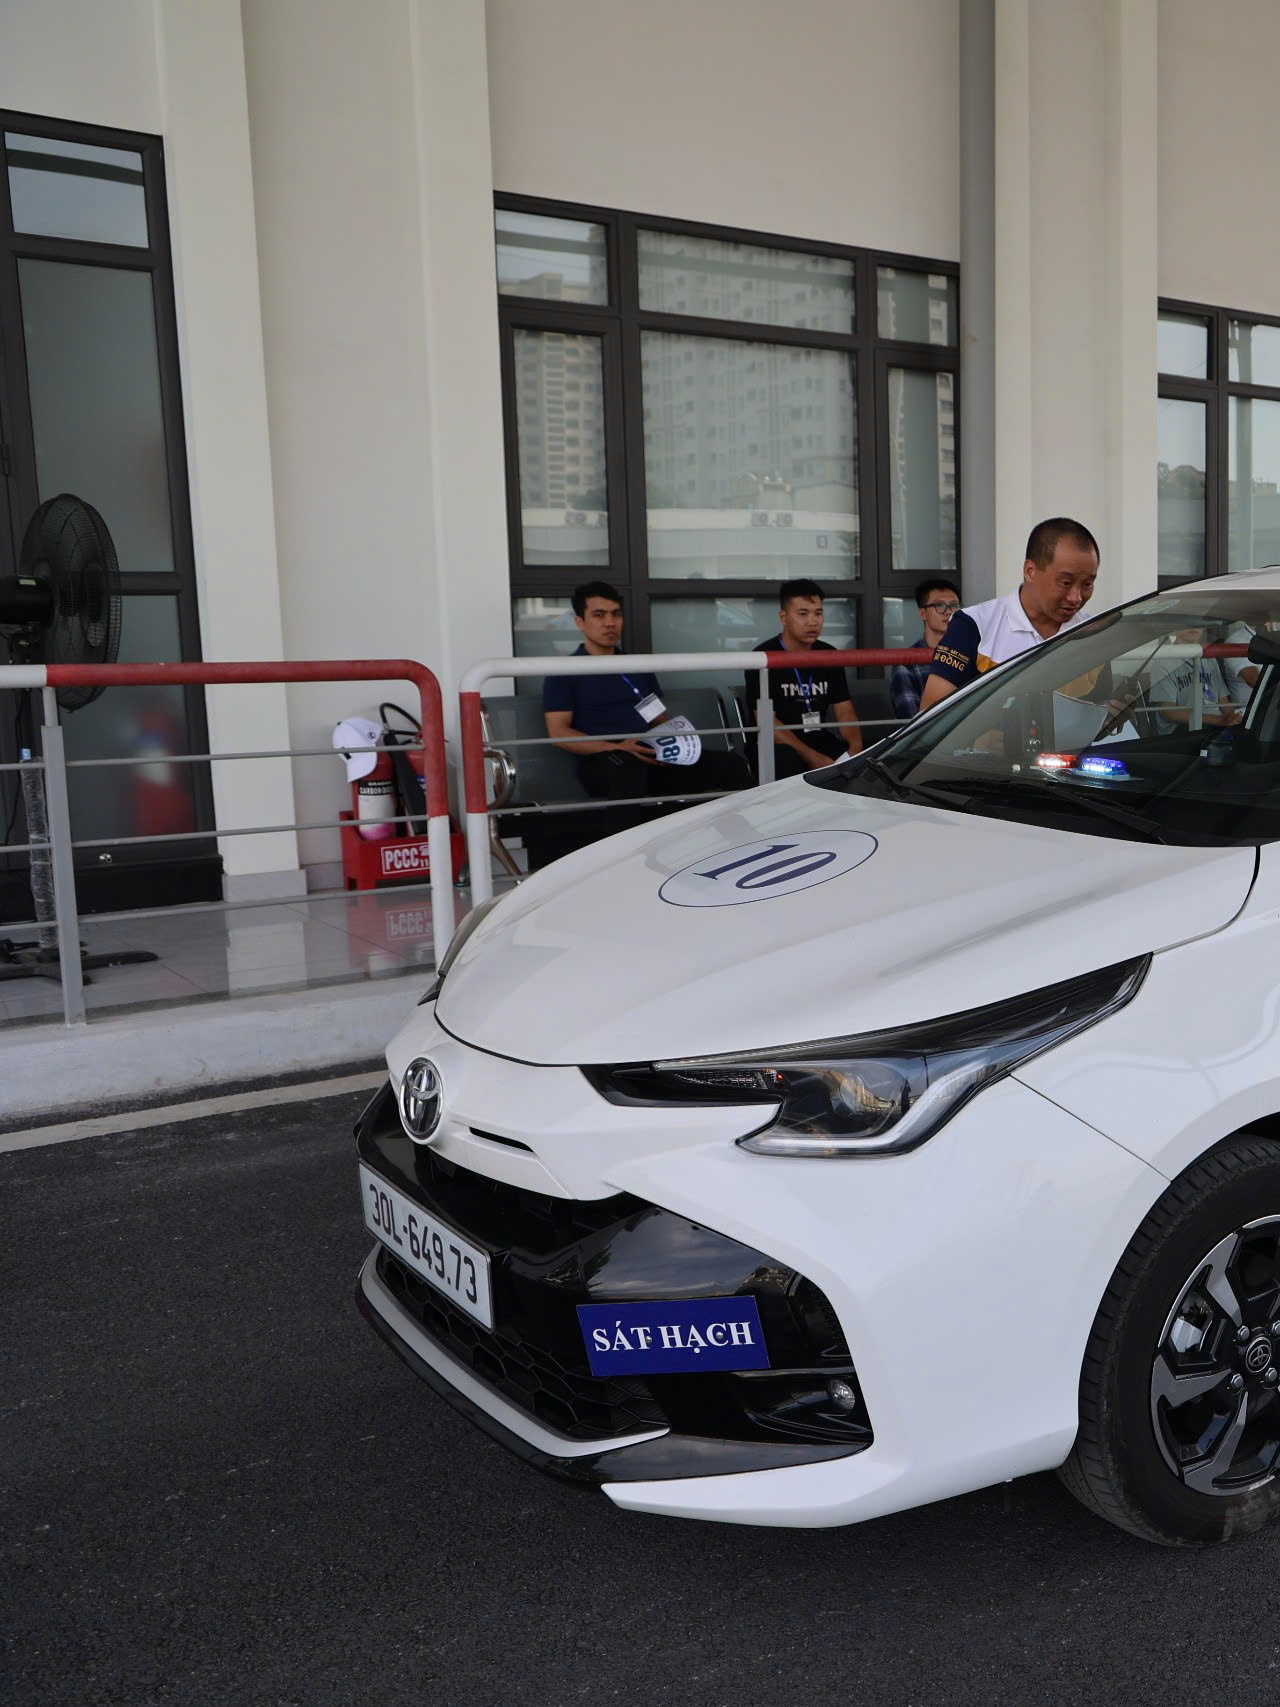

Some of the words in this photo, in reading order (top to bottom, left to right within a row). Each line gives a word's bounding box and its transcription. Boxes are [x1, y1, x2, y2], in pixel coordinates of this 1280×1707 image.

[384, 847, 419, 870] PCCC
[692, 843, 837, 890] 10
[369, 1183, 478, 1304] 30L-649.73
[592, 1320, 651, 1352] SÁT
[657, 1321, 756, 1354] HẠCH
